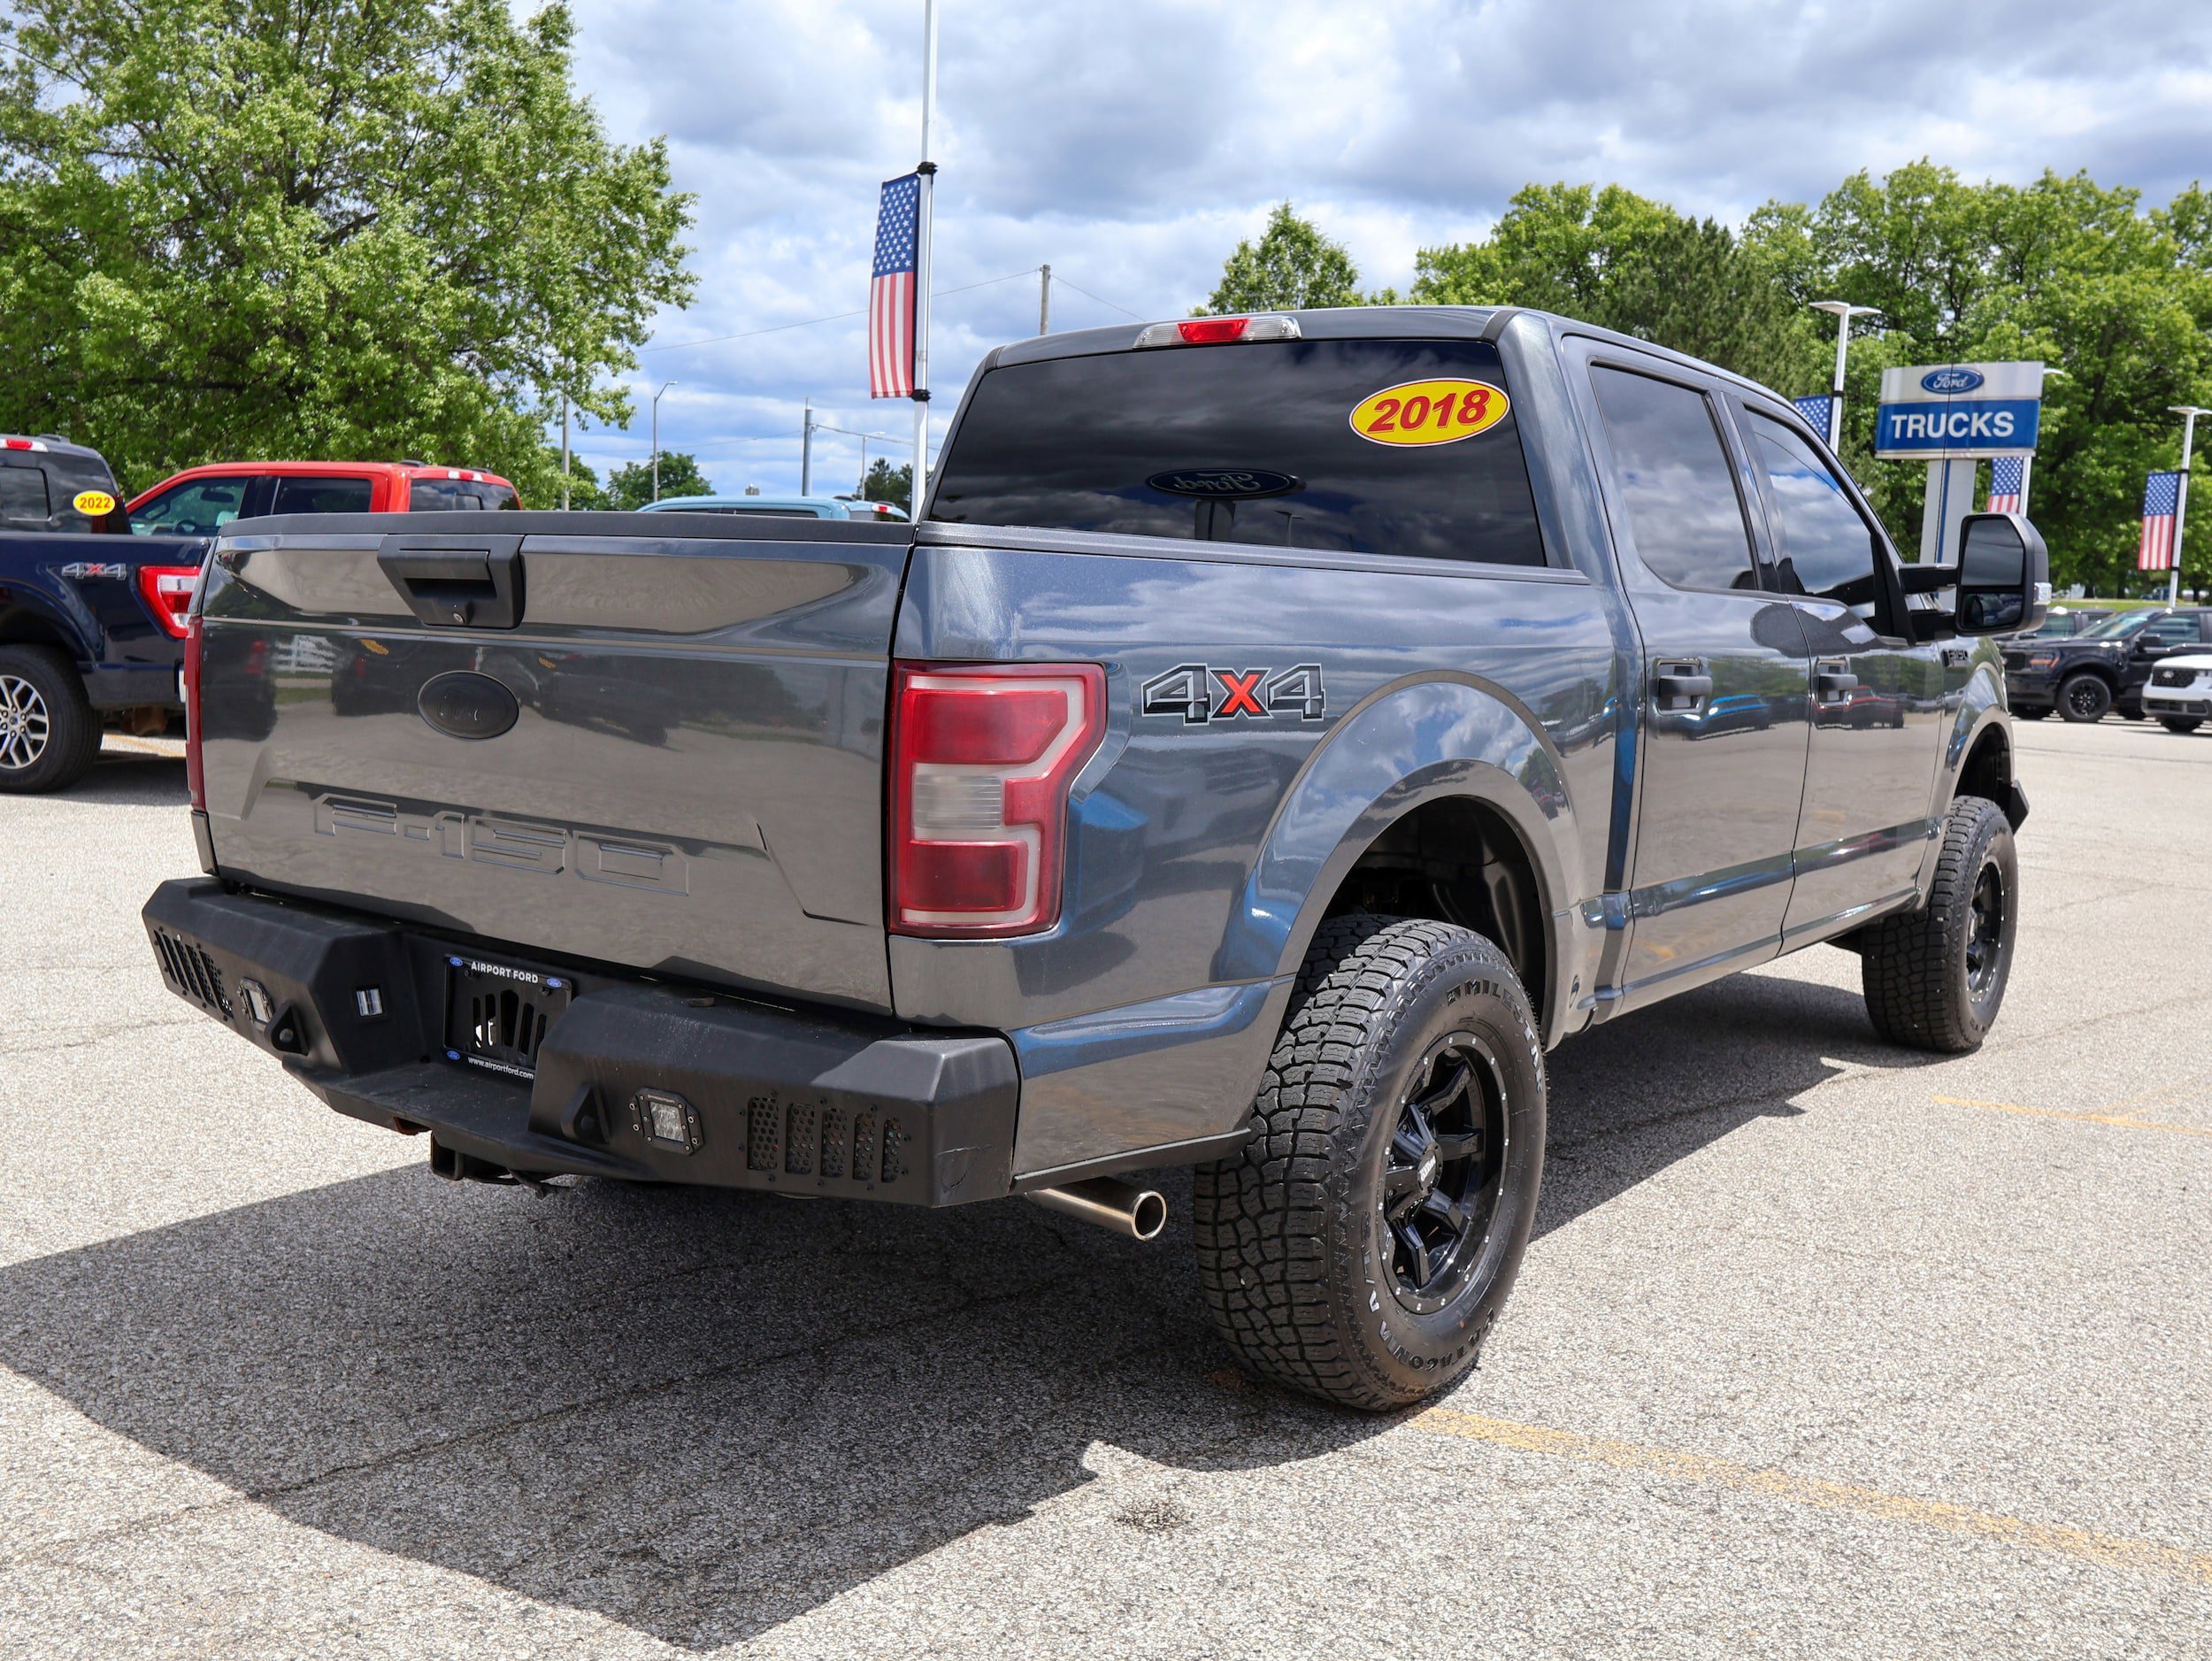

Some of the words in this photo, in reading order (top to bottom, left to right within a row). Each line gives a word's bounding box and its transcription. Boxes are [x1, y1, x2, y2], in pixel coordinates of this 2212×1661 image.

[1932, 373, 1969, 389] Ford
[1366, 389, 1492, 434] 2018
[1891, 411, 2015, 439] TRUCKS
[80, 497, 111, 509] 2022
[471, 961, 511, 979] AIRPORT
[513, 970, 539, 983] FORD
[468, 1057, 534, 1080] www.airportford.com
